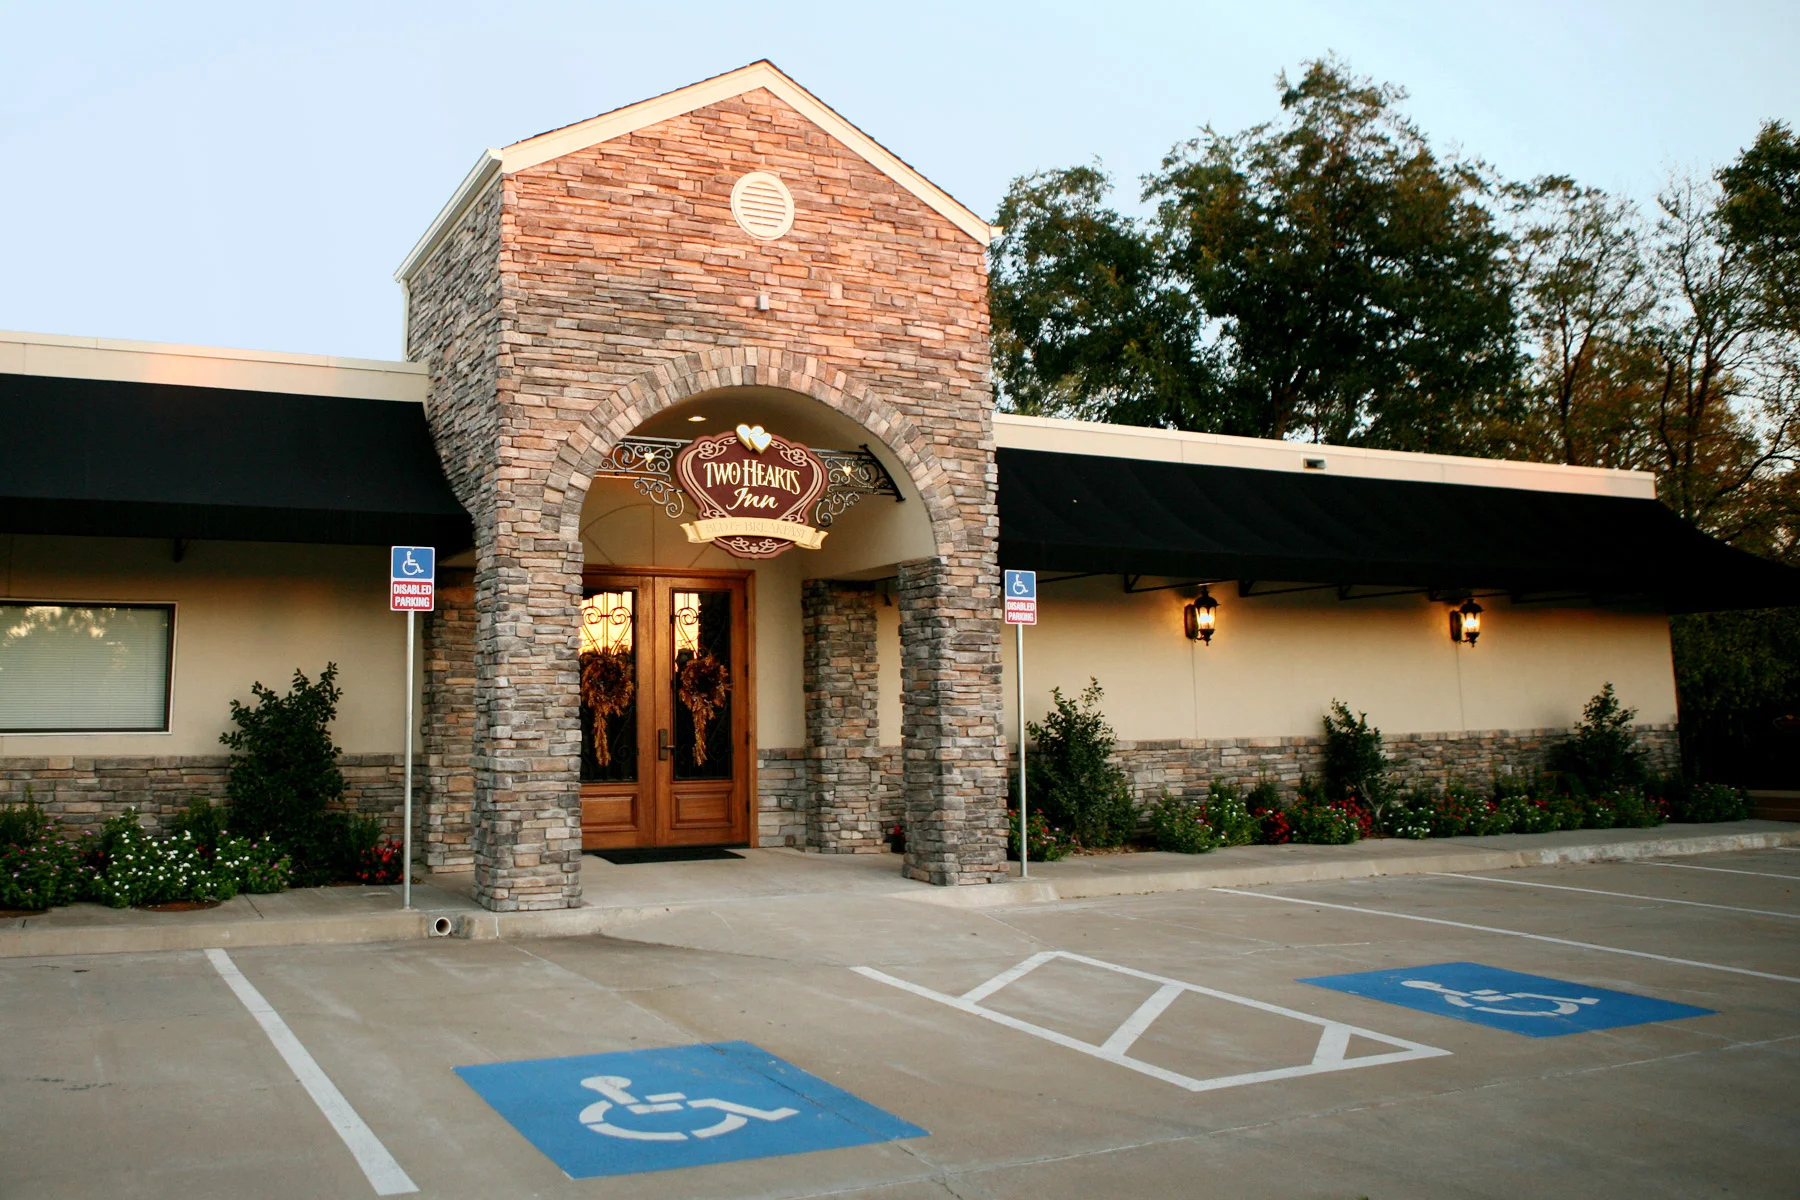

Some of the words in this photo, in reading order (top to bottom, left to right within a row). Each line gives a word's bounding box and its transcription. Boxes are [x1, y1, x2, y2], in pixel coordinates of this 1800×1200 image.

[703, 462, 741, 488] TWO
[742, 459, 801, 495] HEARTS
[726, 487, 779, 510] Inn
[745, 521, 806, 539] BREAKFAST
[393, 584, 432, 595] DISABLED
[394, 596, 430, 607] PARKING
[1007, 601, 1035, 611] DISABLED
[1008, 612, 1034, 621] PARKING
